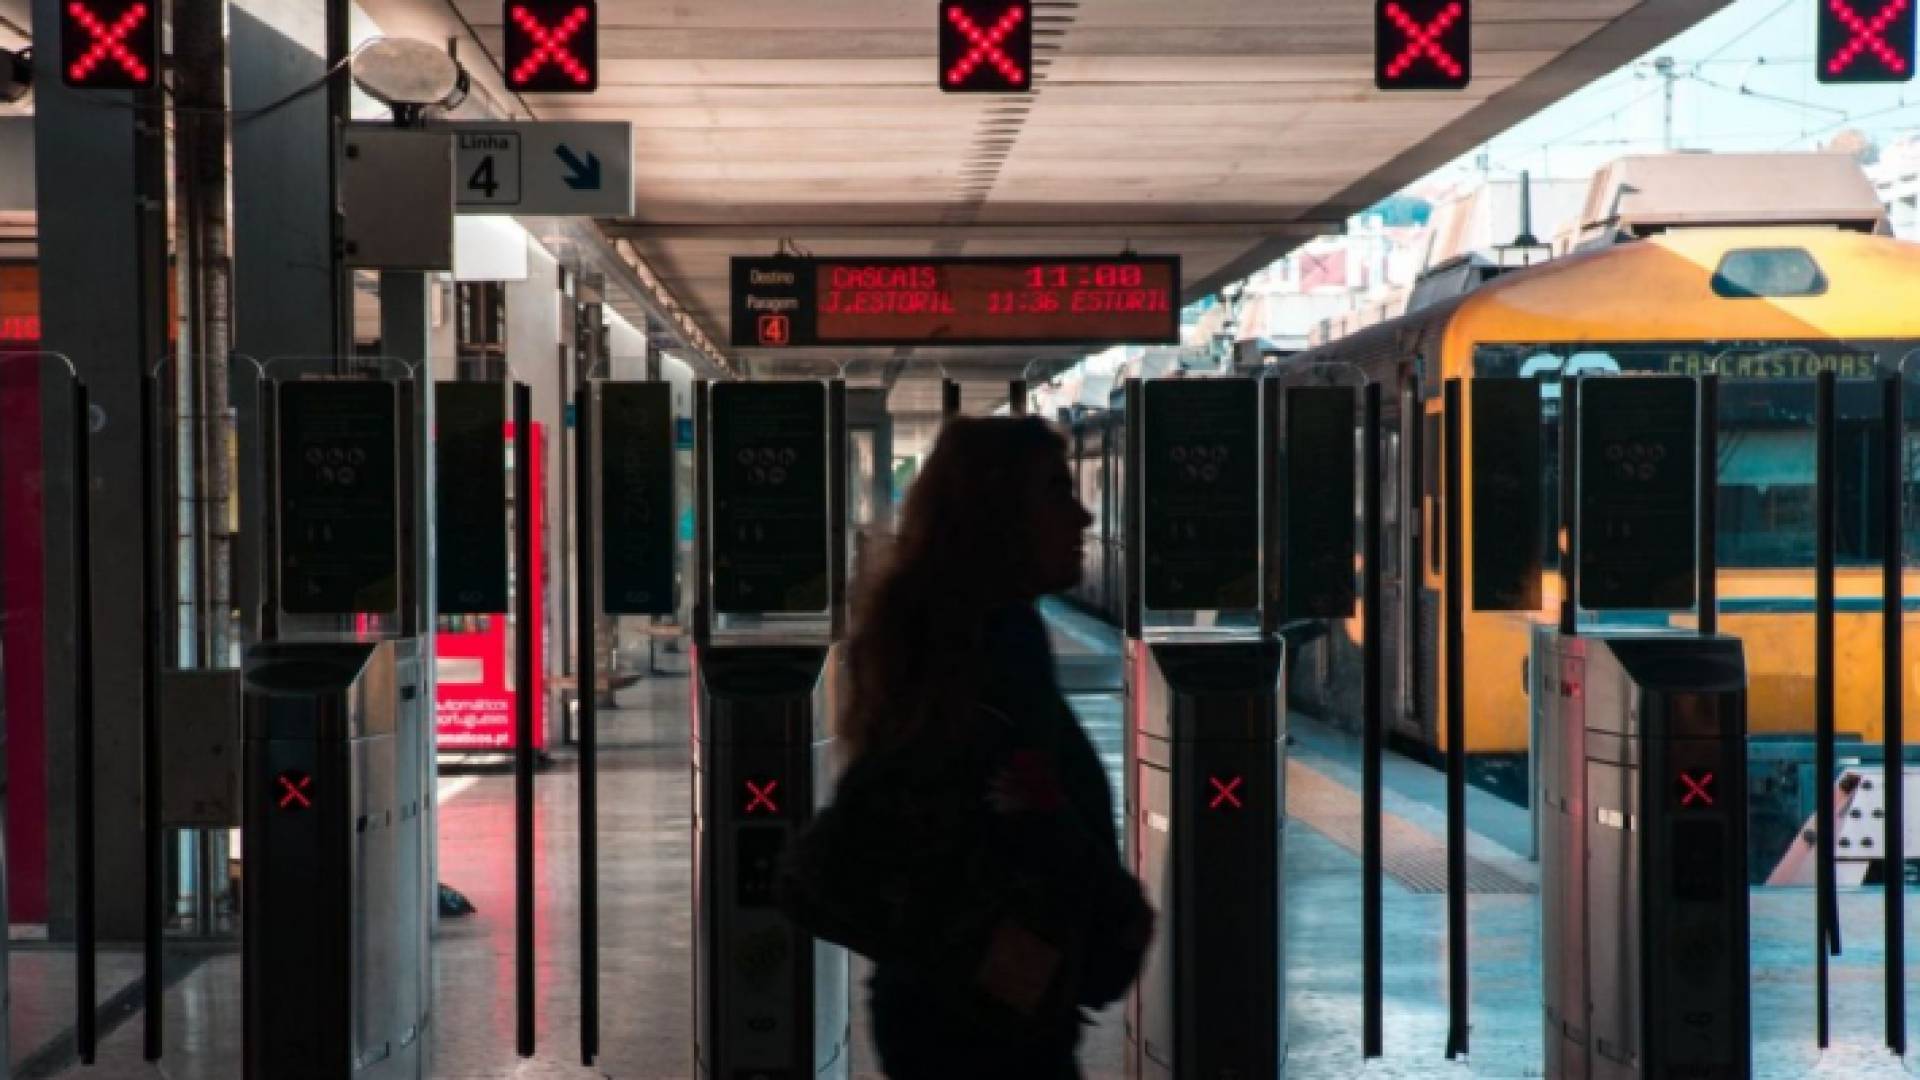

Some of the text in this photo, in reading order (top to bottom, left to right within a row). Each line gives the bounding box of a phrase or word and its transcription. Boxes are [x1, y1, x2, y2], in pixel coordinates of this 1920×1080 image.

[461, 135, 508, 149] Linha
[469, 156, 499, 198] 4
[833, 266, 1142, 288] CASCAIS 11:00
